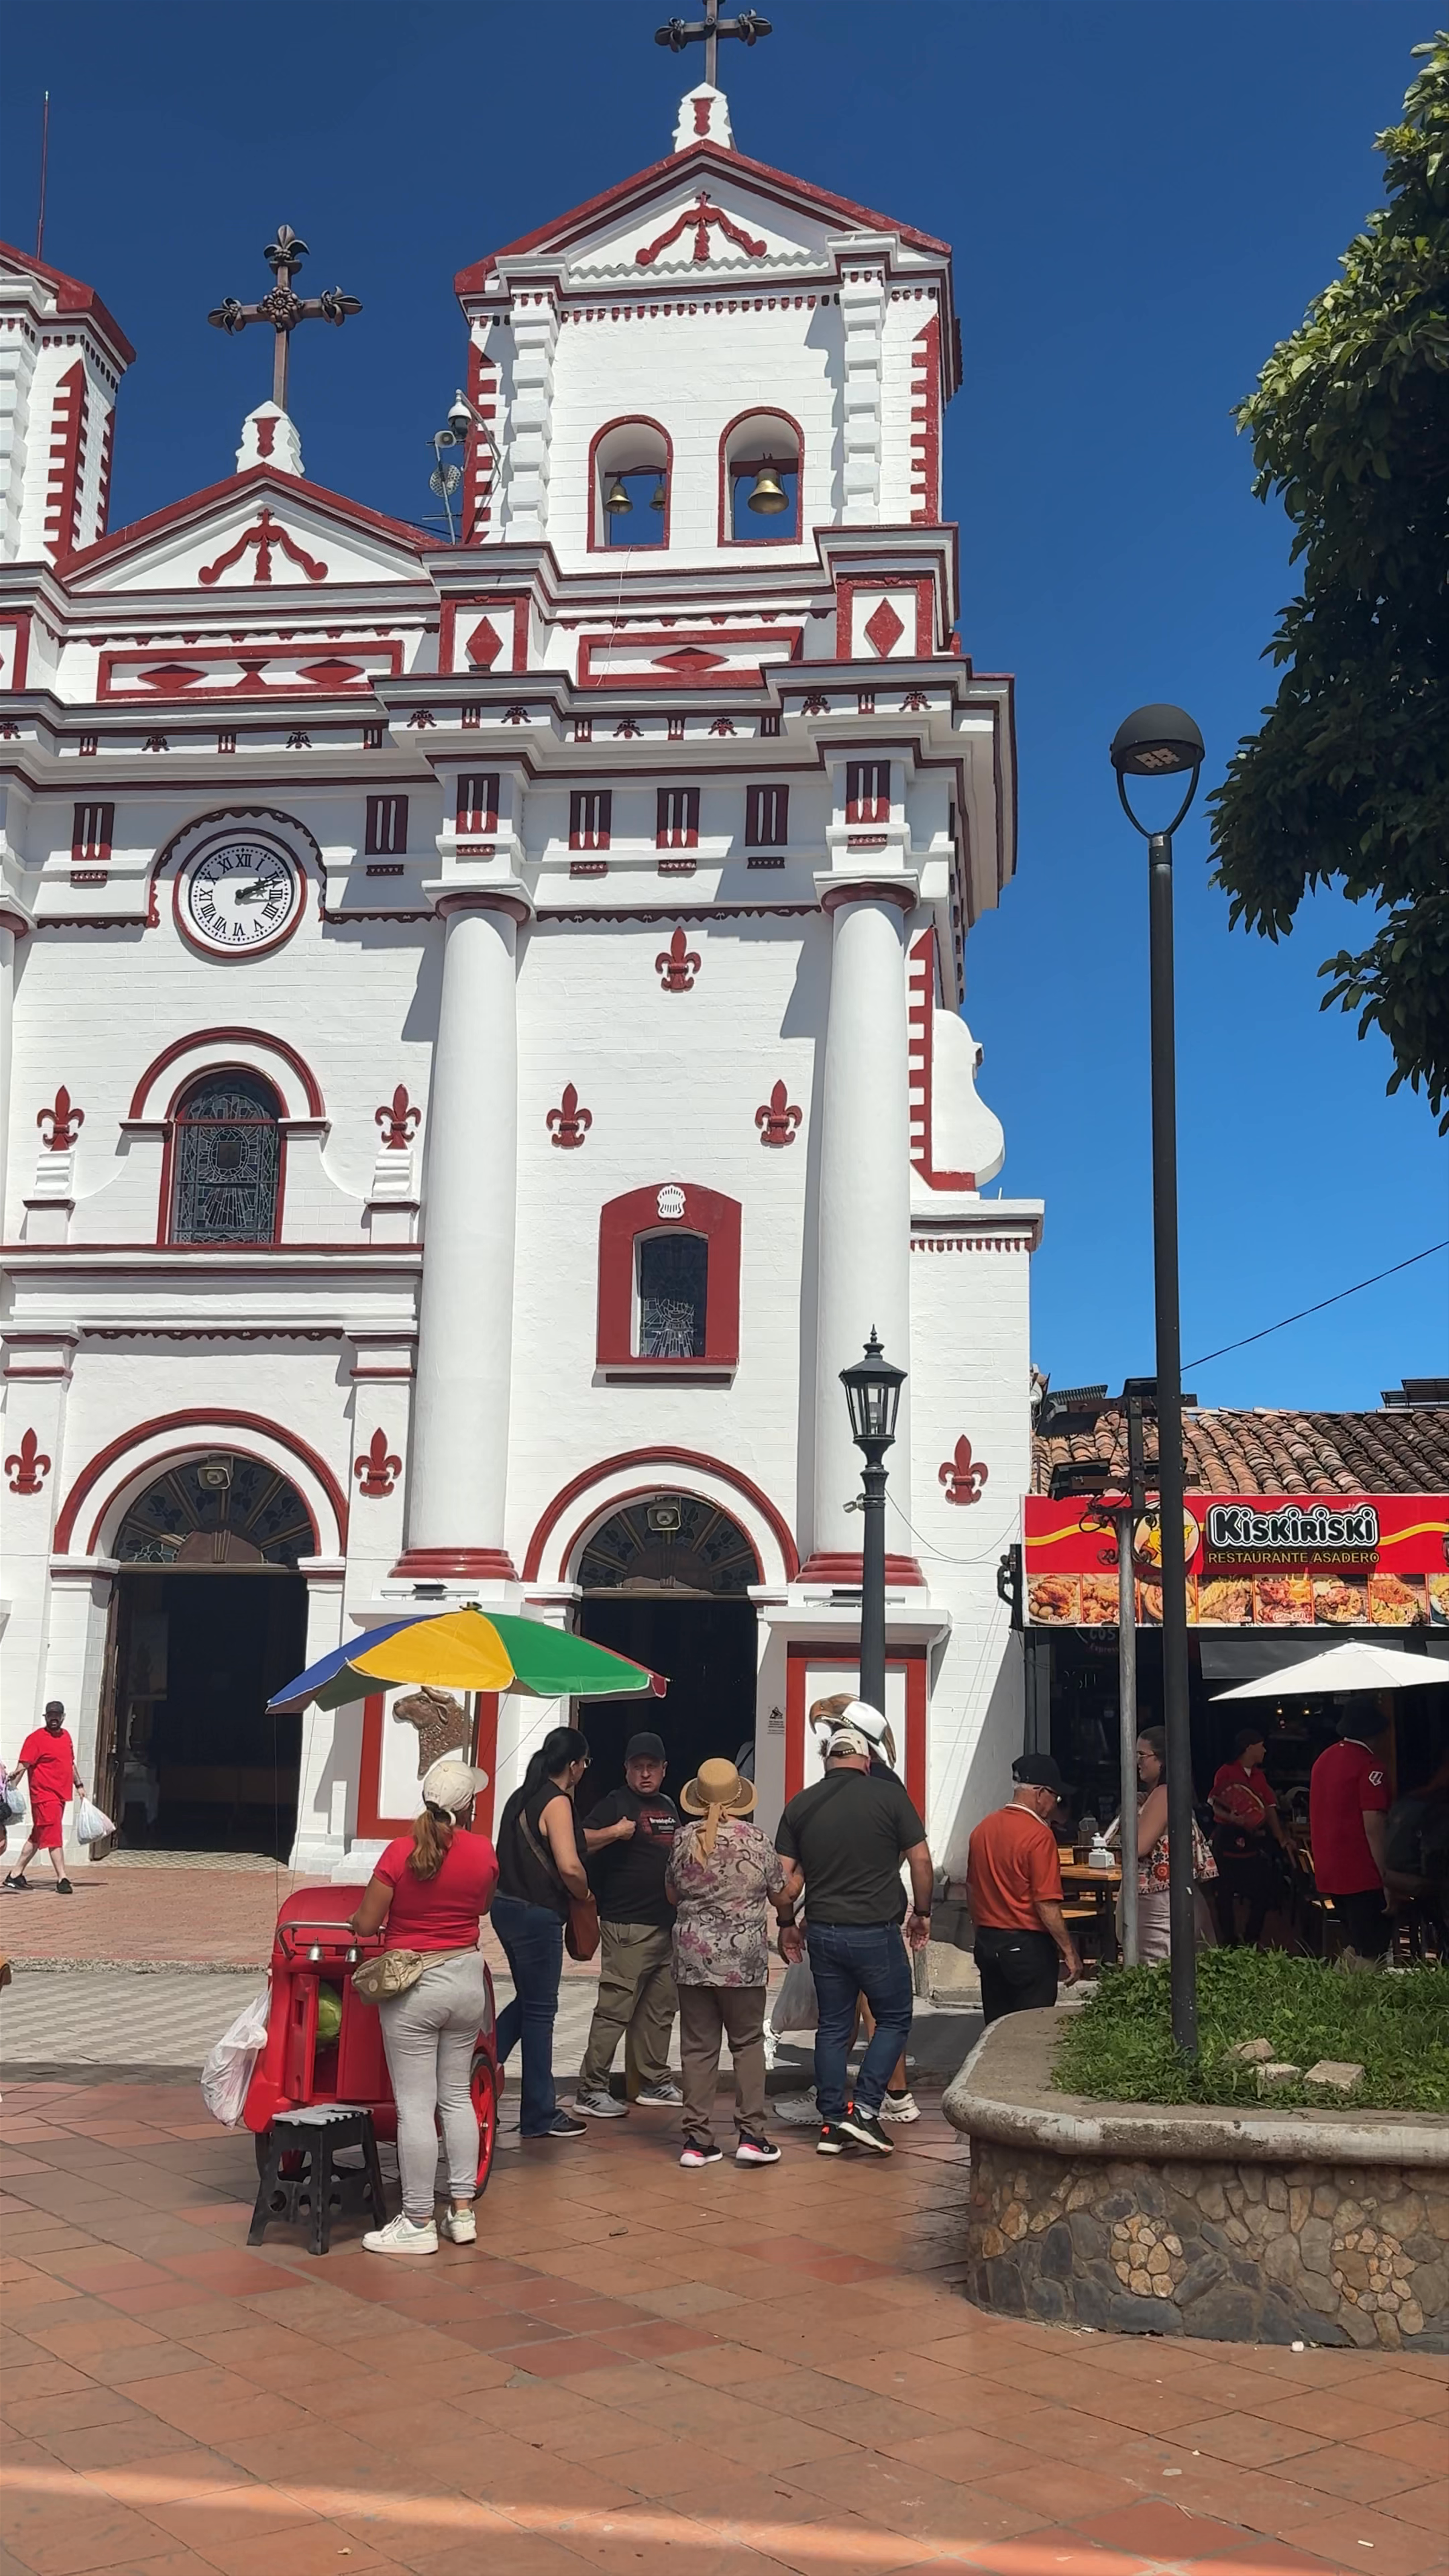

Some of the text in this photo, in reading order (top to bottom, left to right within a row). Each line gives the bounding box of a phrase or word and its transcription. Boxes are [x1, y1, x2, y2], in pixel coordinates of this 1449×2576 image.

[217, 857, 234, 874] XI
[235, 854, 252, 867] XII
[255, 858, 265, 871] I
[204, 871, 220, 886] X
[199, 889, 213, 901] IX
[269, 889, 283, 900] III
[200, 903, 217, 923] VIII
[261, 902, 279, 921] IIII
[212, 916, 227, 934] VII
[232, 923, 246, 936] VI
[254, 918, 264, 932] V
[1208, 1552, 1380, 1563] RESTAURANTE ASADERO
